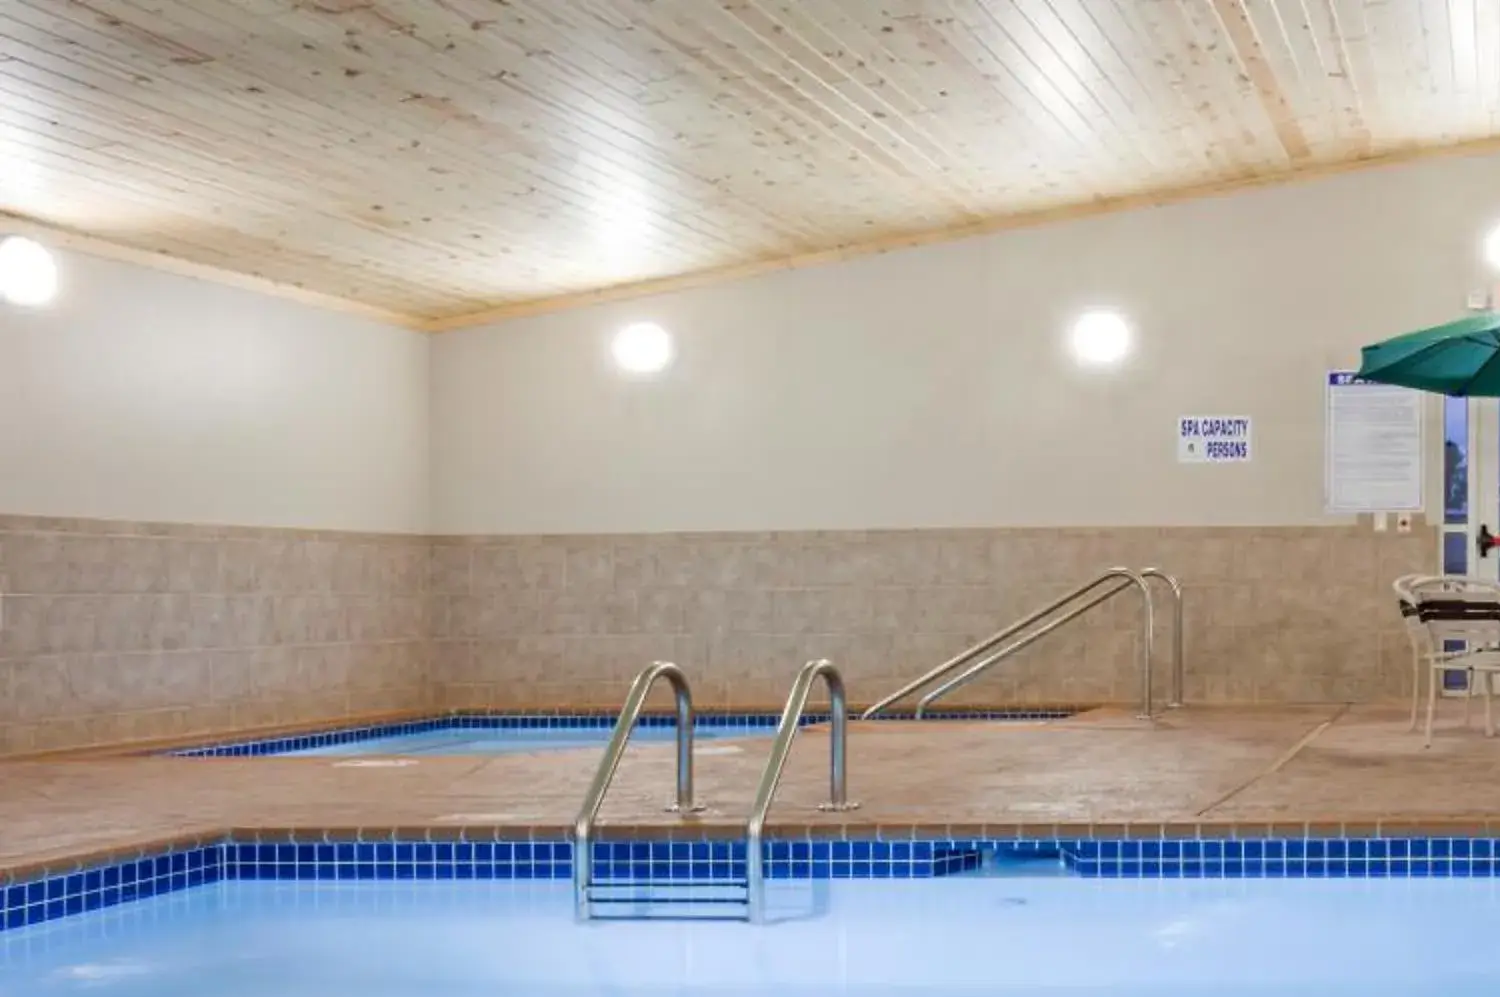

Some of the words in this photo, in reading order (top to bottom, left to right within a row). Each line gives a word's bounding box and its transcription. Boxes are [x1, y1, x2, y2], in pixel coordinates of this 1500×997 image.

[1181, 419, 1200, 437] SPA
[1201, 419, 1248, 437] CAPACITY
[1206, 441, 1247, 458] PERSONS
